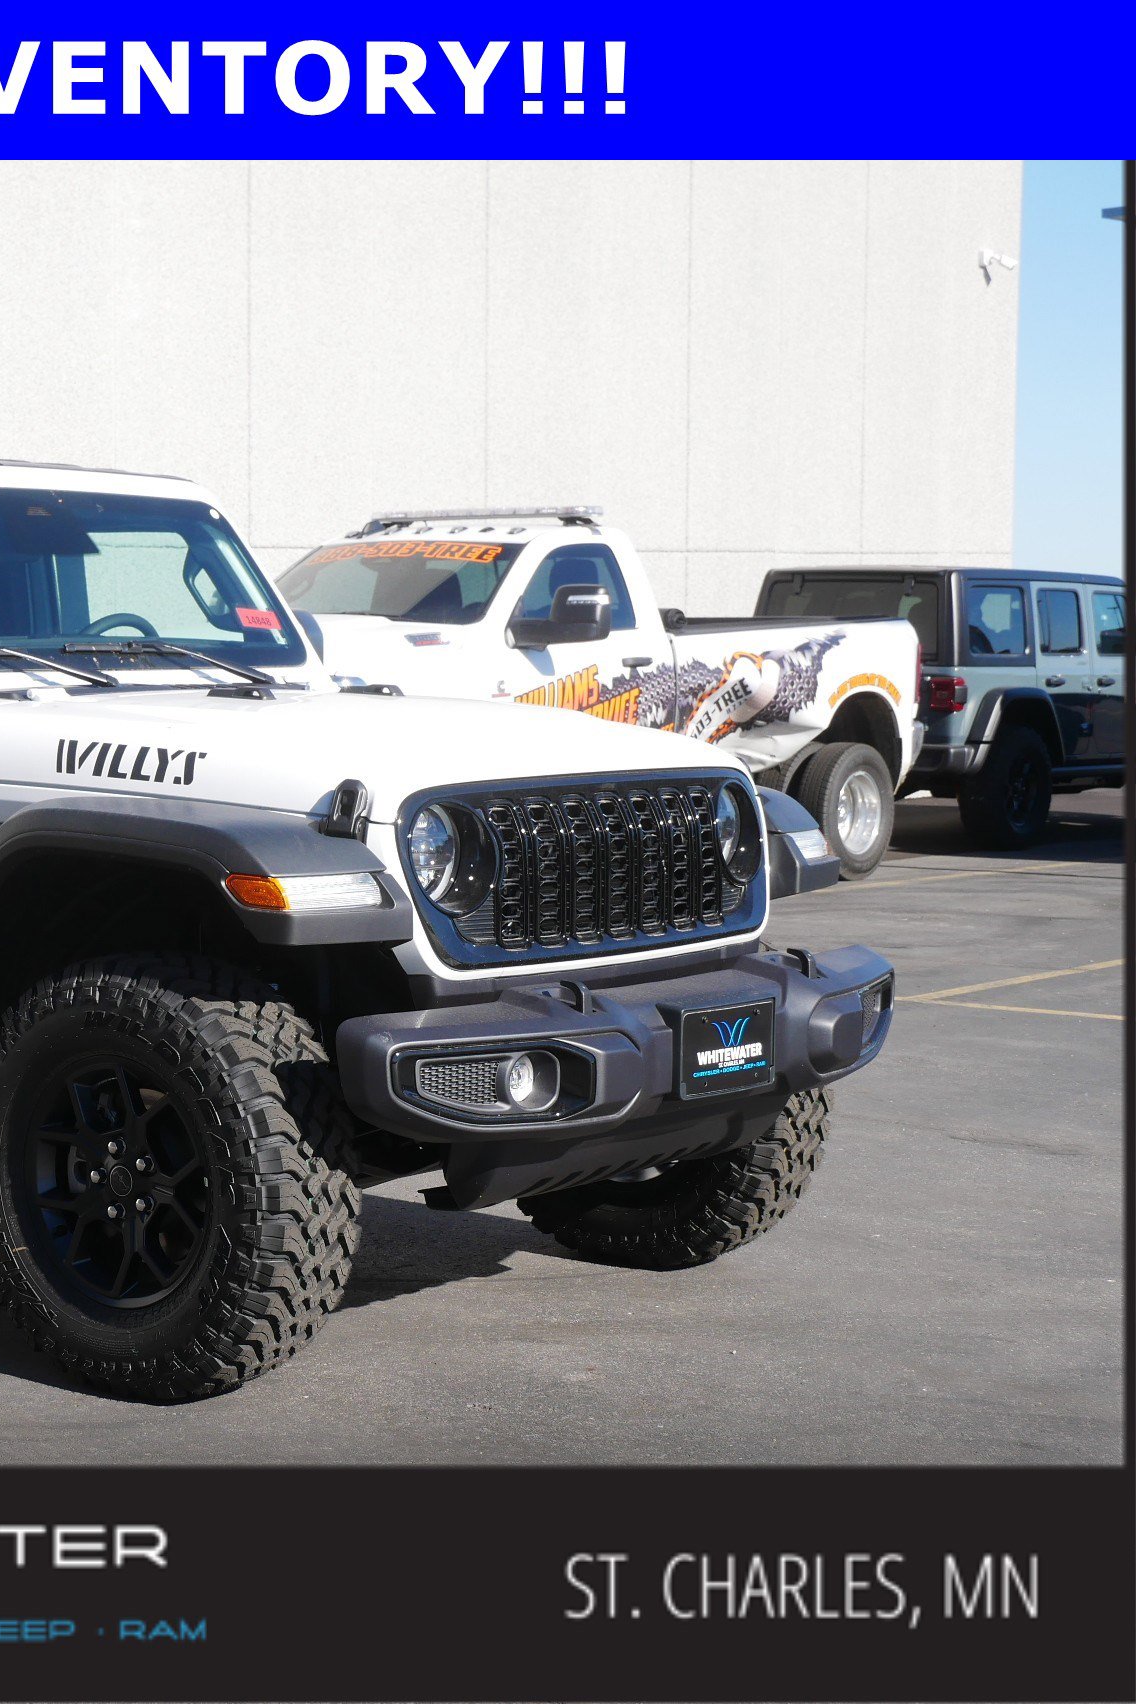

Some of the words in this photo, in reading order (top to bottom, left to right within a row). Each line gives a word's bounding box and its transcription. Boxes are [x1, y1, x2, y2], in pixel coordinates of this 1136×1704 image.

[514, 664, 599, 711] LLIAMS
[56, 738, 208, 786] WILLYS
[697, 1042, 763, 1066] WHITEWATER
